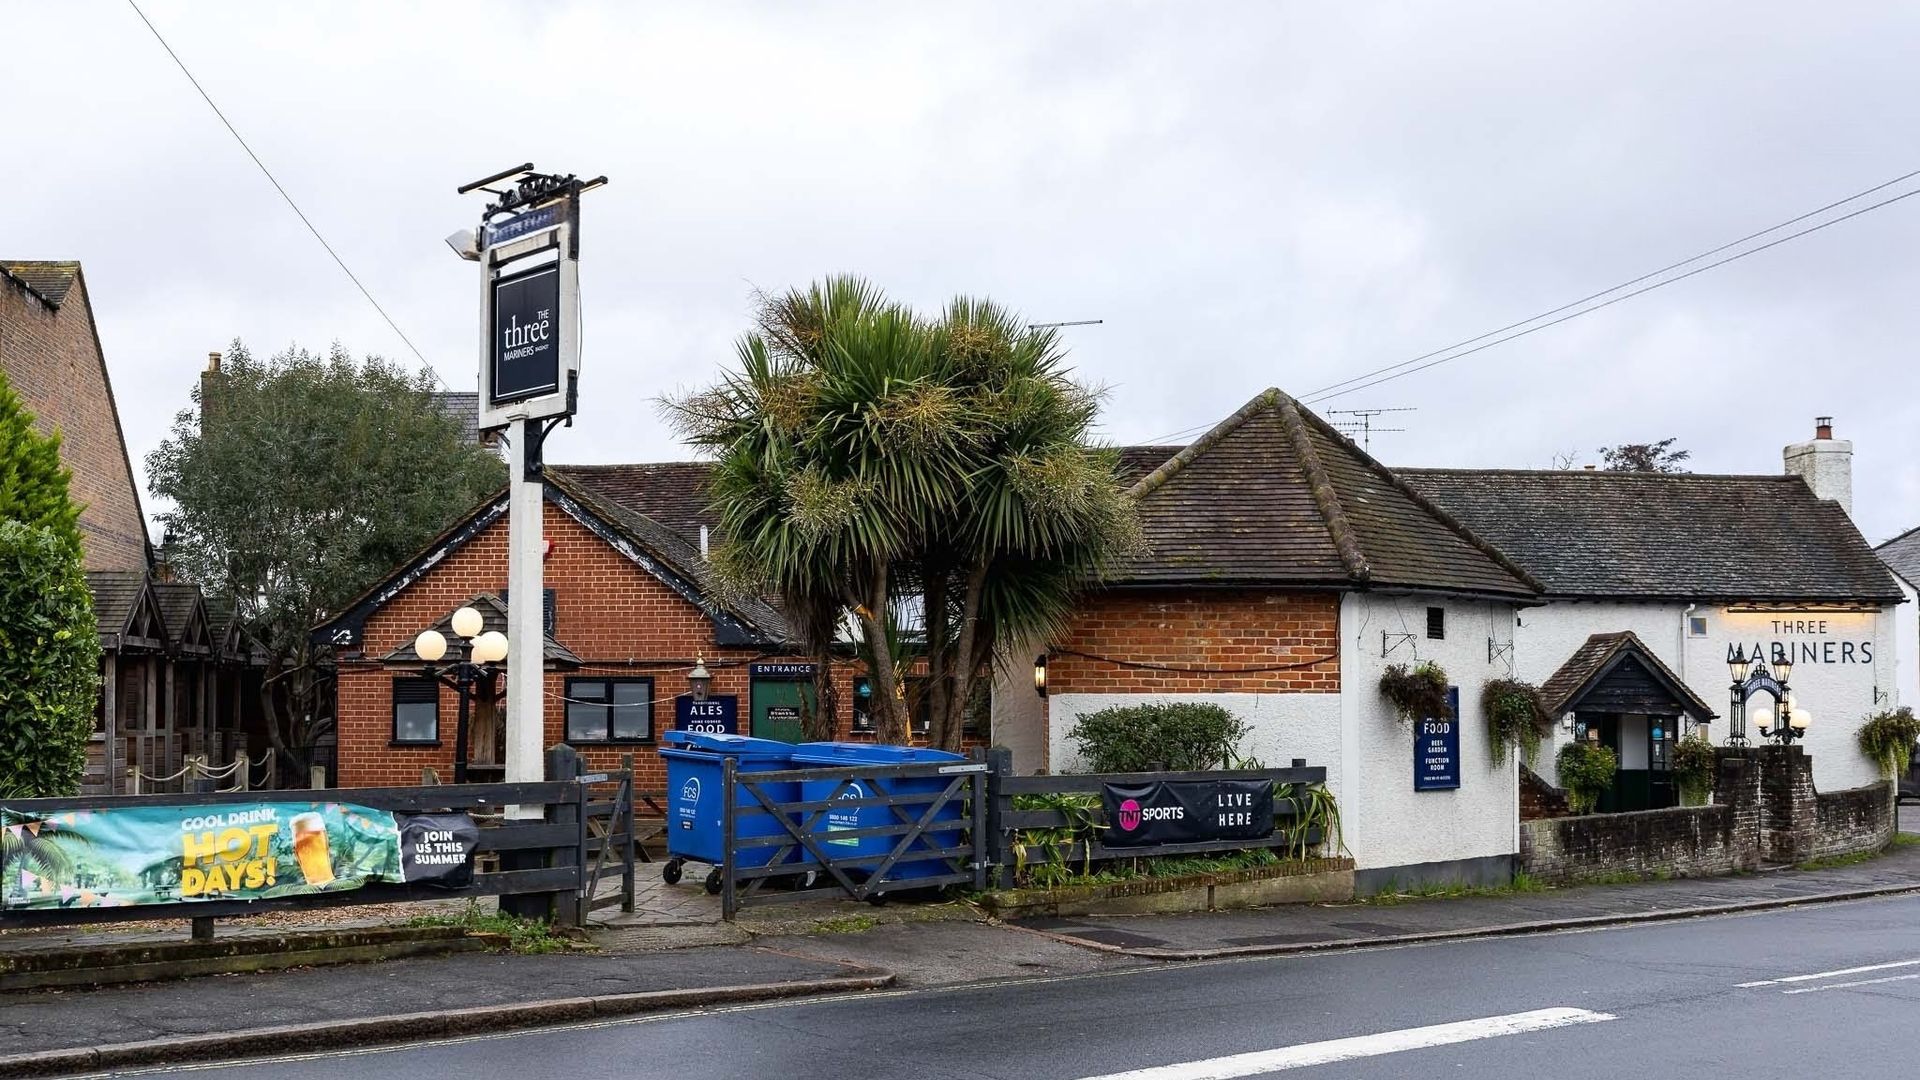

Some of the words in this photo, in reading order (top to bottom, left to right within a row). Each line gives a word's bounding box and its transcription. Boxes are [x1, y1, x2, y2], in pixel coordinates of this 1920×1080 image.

[537, 309, 549, 320] THE
[504, 315, 549, 349] three
[503, 346, 534, 361] MARINERS
[1771, 620, 1827, 634] THREE
[1726, 641, 1873, 664] MARINERS
[757, 665, 811, 673] ENTRANCE
[690, 705, 723, 716] ALES
[687, 724, 725, 734] FOOD
[1424, 722, 1450, 734] FOOD
[683, 786, 697, 799] FCS
[1218, 793, 1252, 807] LIVE
[1142, 806, 1184, 821] SPORTS
[1218, 812, 1252, 827] HERE
[181, 814, 226, 830] COOL
[423, 830, 453, 844] JOIN
[182, 823, 279, 868] HOT
[415, 843, 432, 853] US
[433, 841, 463, 853] THIS
[414, 853, 467, 865] SUMMER
[181, 857, 278, 897] DAYS!
